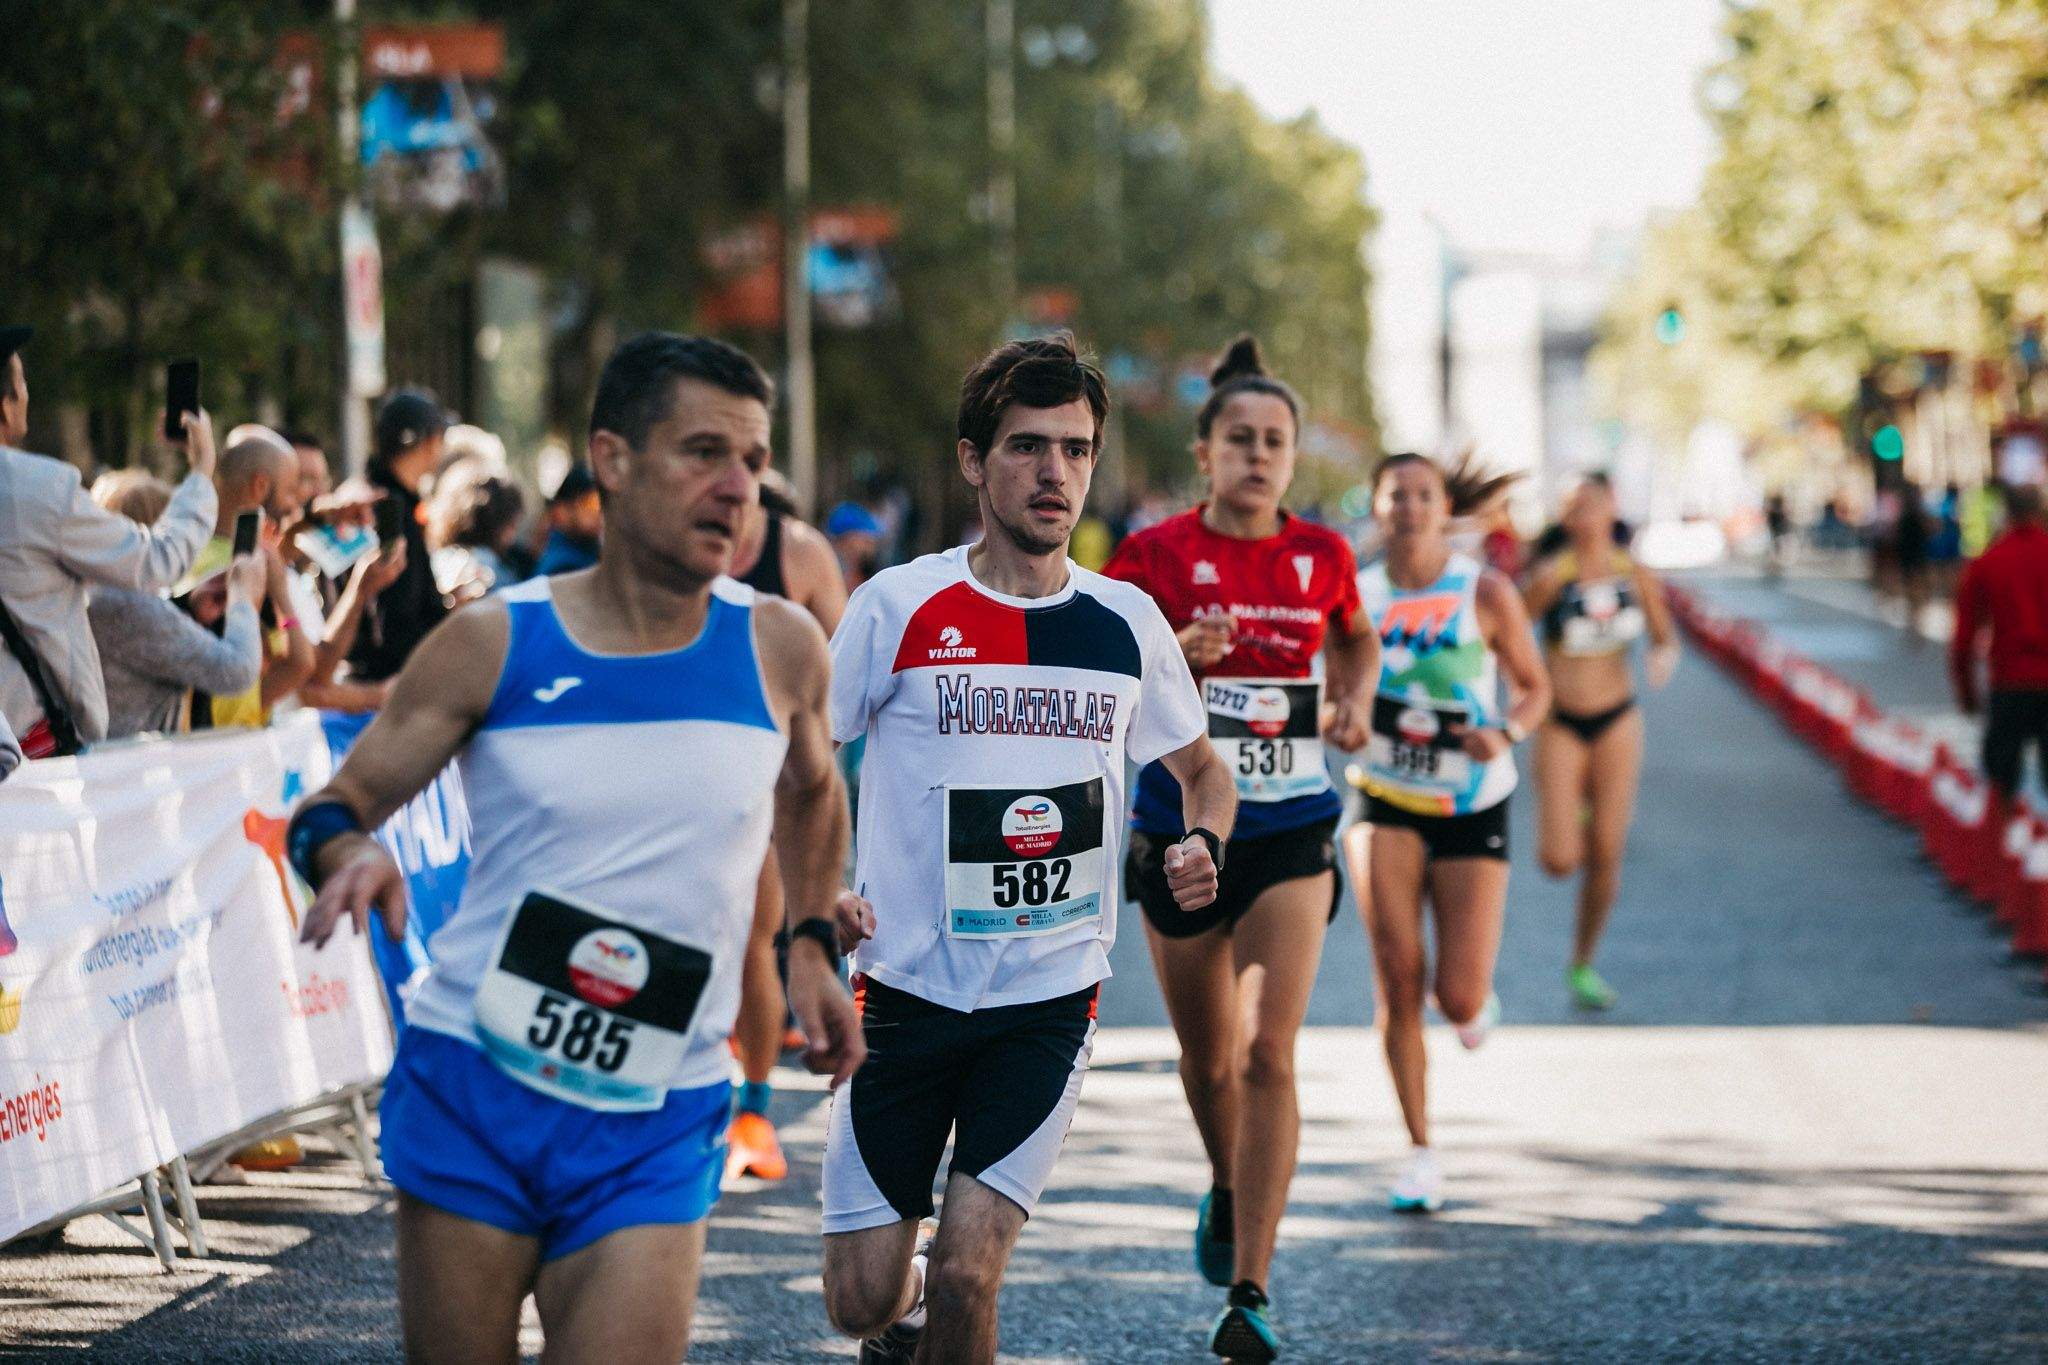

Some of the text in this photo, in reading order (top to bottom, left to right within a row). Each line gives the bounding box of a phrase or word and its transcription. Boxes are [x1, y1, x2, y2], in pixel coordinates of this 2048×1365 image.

[928, 647, 976, 659] VIATOR
[936, 673, 1117, 743] MORATALAZ
[1239, 741, 1293, 775] 530
[1023, 835, 1044, 843] MILLA
[1026, 841, 1052, 849] MADRID
[993, 858, 1072, 908] 582
[969, 917, 1006, 927] MADRID
[527, 993, 638, 1073] 585
